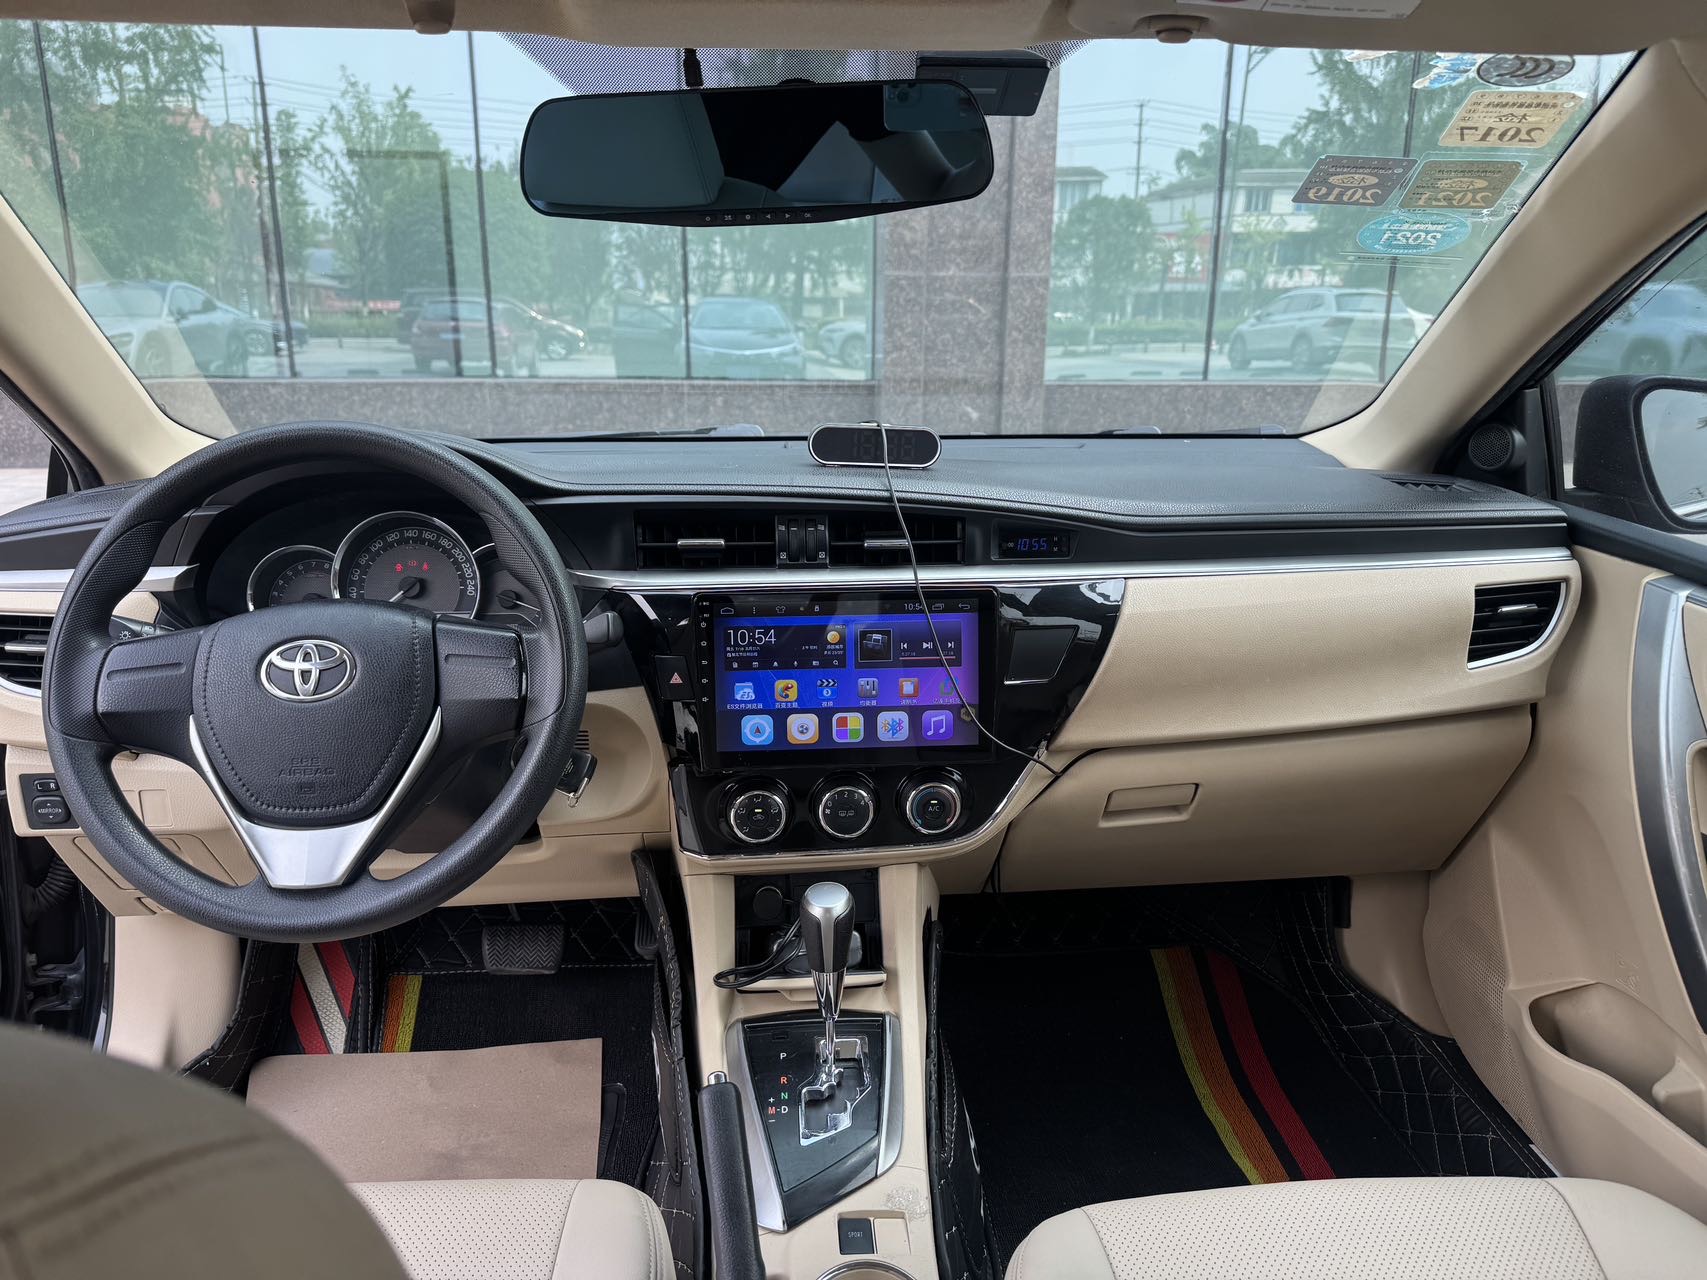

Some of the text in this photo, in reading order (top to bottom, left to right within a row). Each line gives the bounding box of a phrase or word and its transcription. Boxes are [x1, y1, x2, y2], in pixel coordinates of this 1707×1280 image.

[386, 532, 400, 543] 120
[404, 529, 418, 537] 140
[422, 531, 437, 541] 160
[369, 539, 384, 553] 100
[438, 537, 453, 549] 180
[358, 554, 369, 565] 80
[451, 547, 466, 562] 200
[351, 568, 361, 580] 60
[462, 562, 474, 578] 220
[467, 579, 475, 596] 240
[727, 628, 777, 646] 10:54
[278, 768, 336, 777] AIRBAG
[780, 1076, 788, 1084] R
